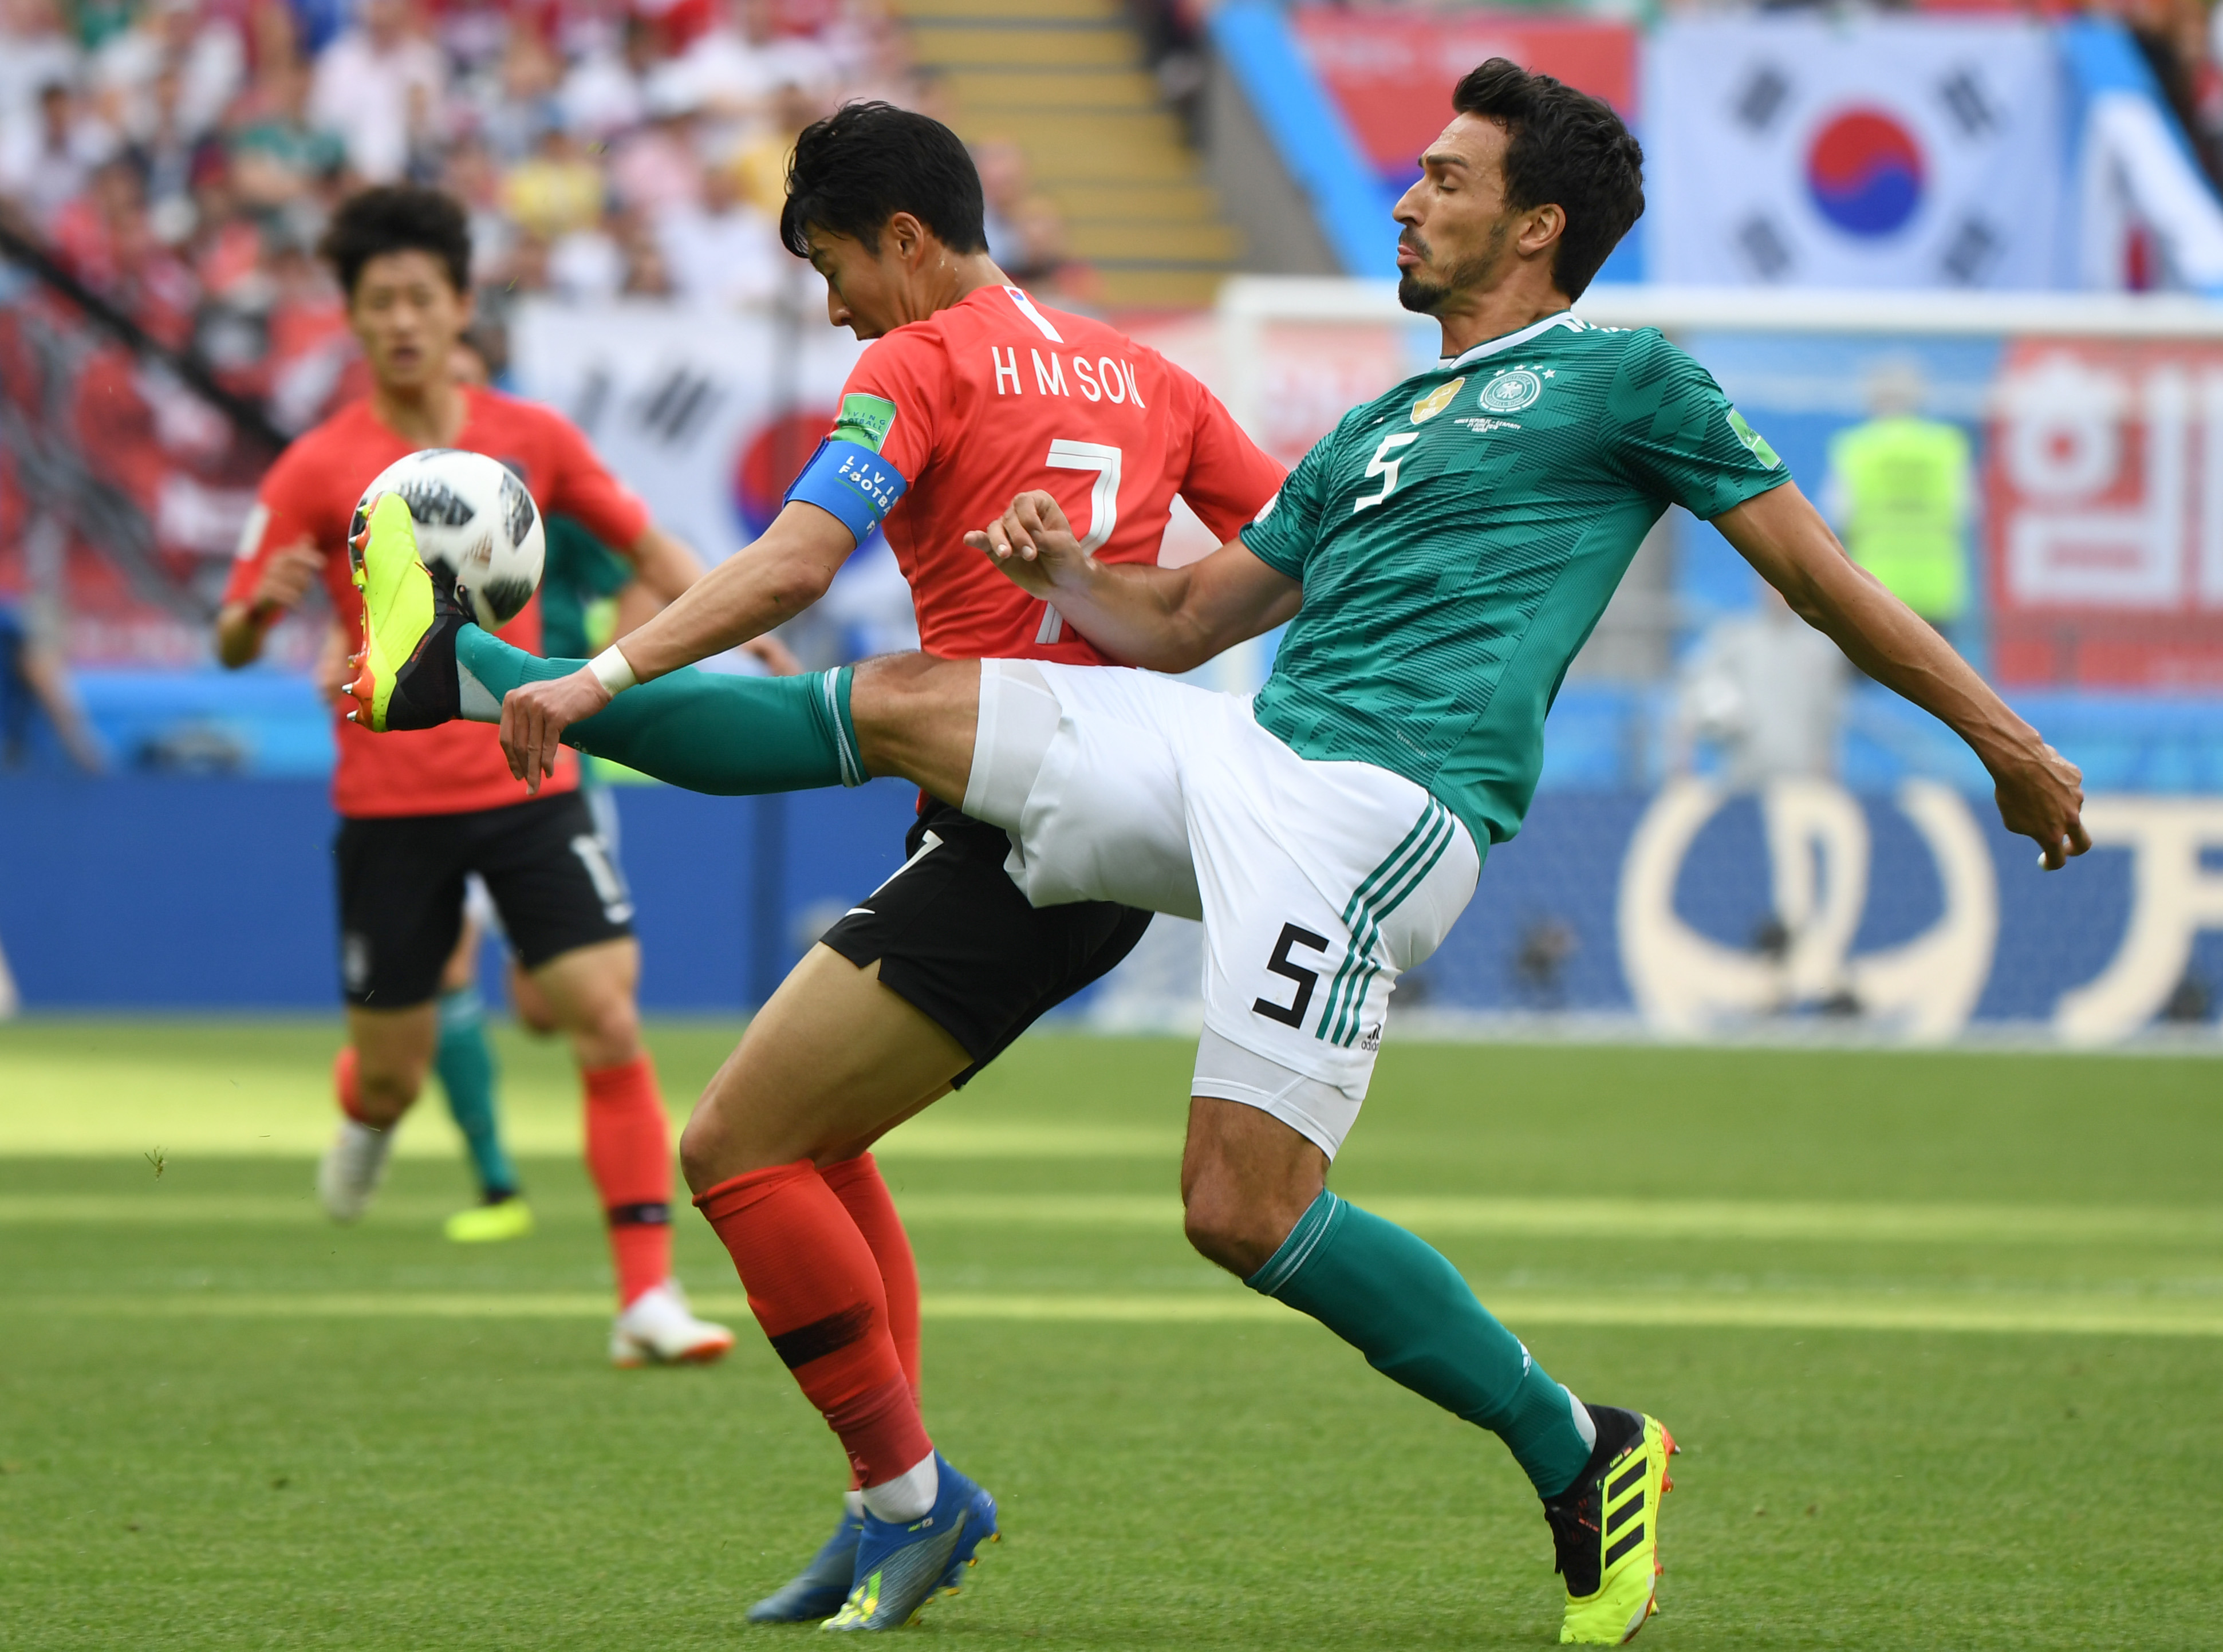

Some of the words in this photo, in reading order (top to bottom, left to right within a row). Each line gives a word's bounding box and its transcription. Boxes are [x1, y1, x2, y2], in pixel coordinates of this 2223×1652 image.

[991, 346, 1022, 395] H
[1031, 348, 1070, 397] M
[1073, 356, 1146, 408] SON
[847, 411, 886, 425] IVING
[1353, 432, 1420, 513] 5
[1034, 439, 1122, 644] 7
[1252, 922, 1330, 1030] 5
